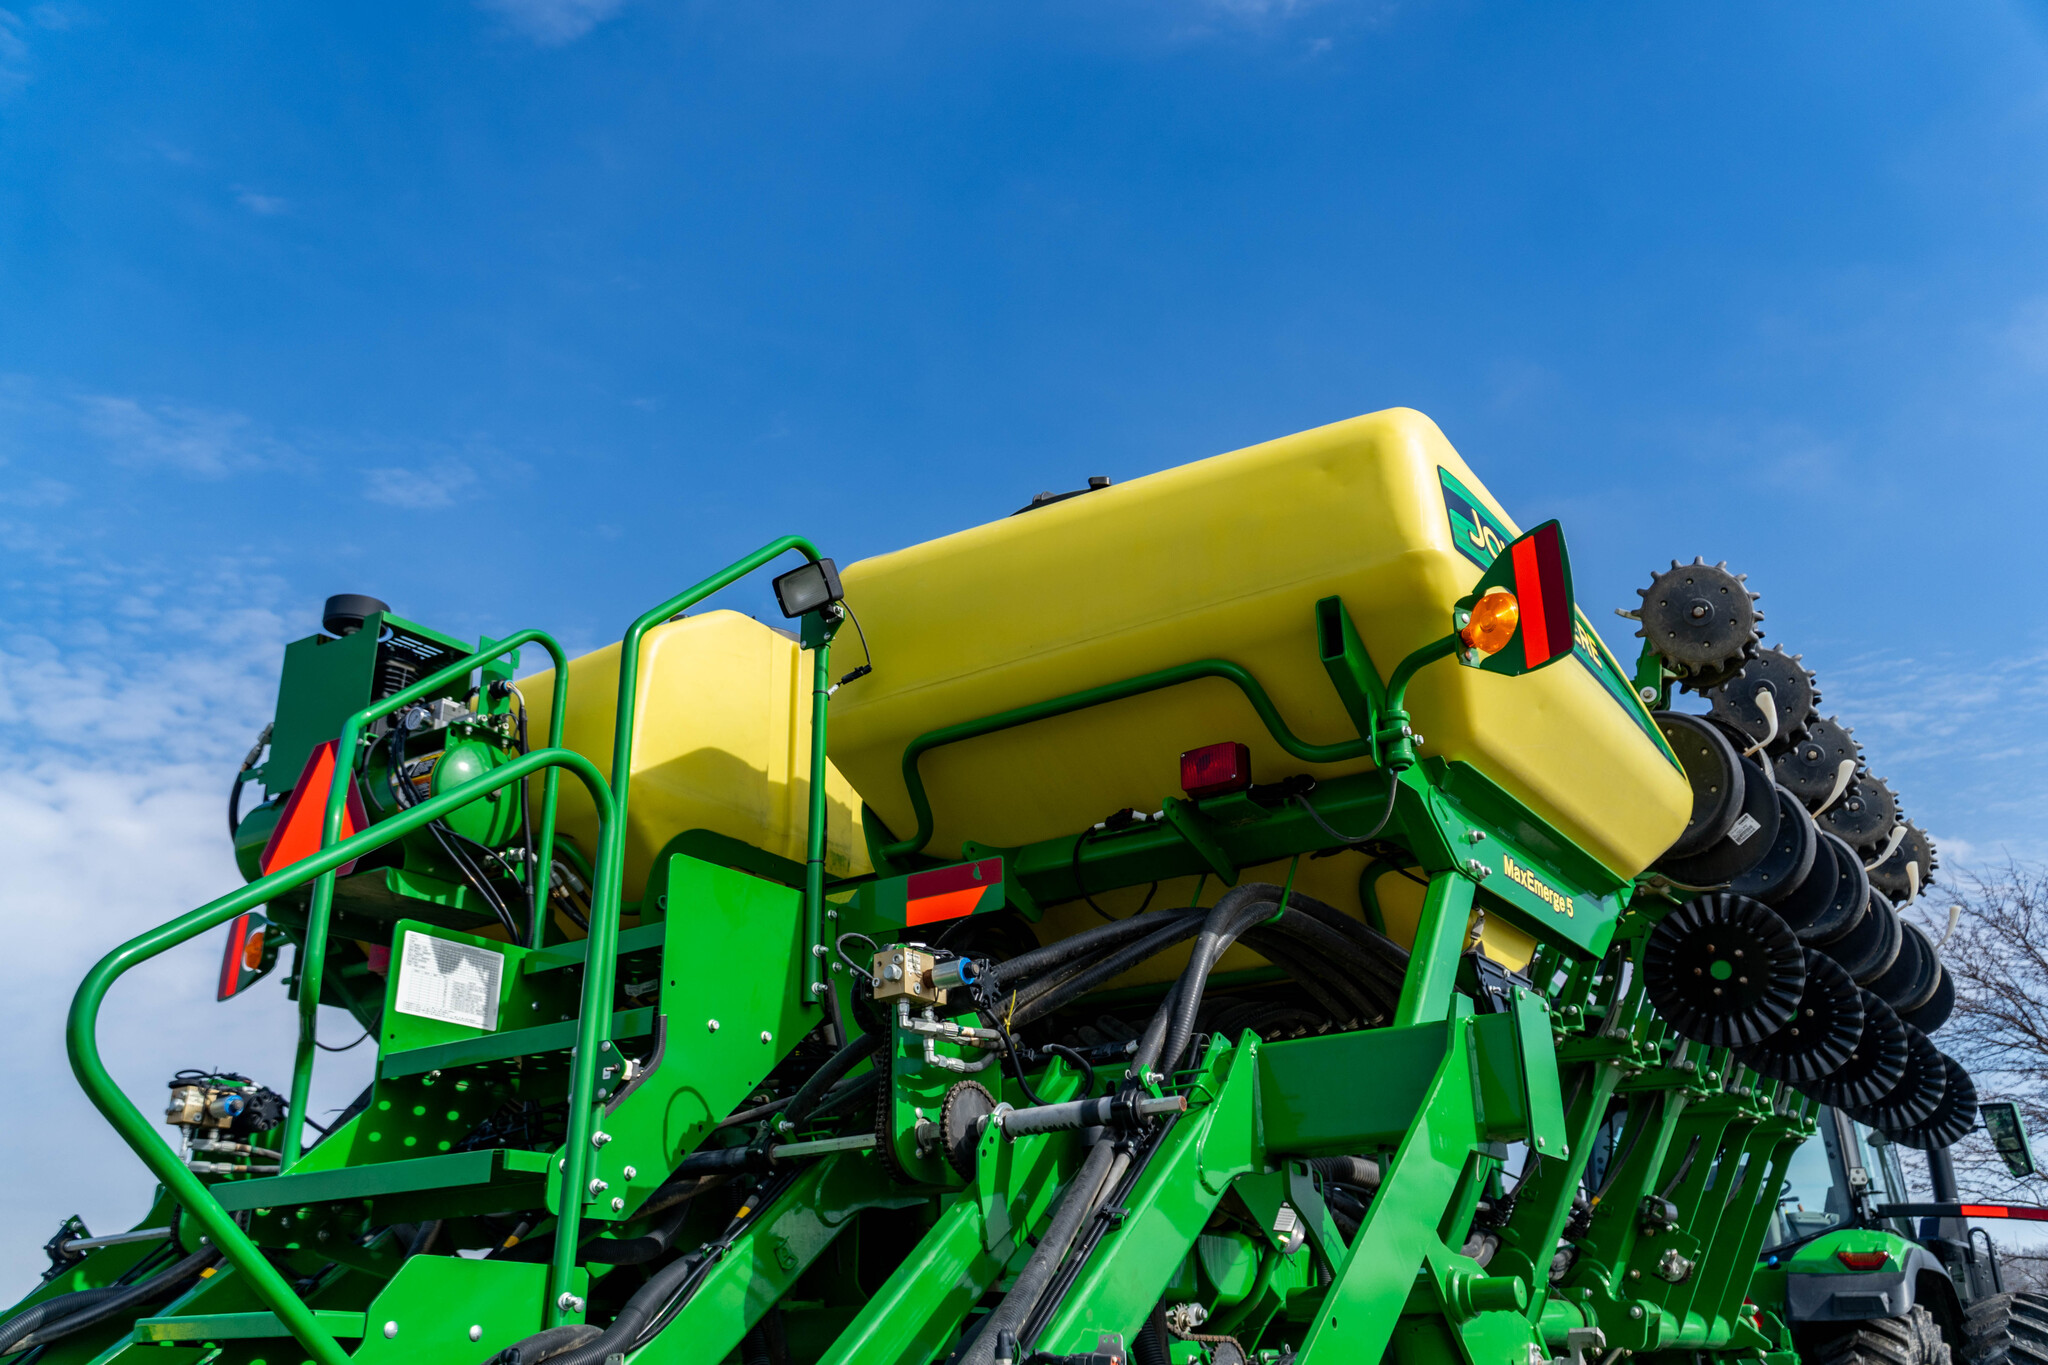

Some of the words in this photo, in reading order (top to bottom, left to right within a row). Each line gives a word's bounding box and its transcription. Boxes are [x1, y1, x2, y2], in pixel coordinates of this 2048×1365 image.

[1469, 508, 1506, 559] JO
[1503, 854, 1566, 913] MaxEmerge
[1566, 896, 1574, 918] 5
